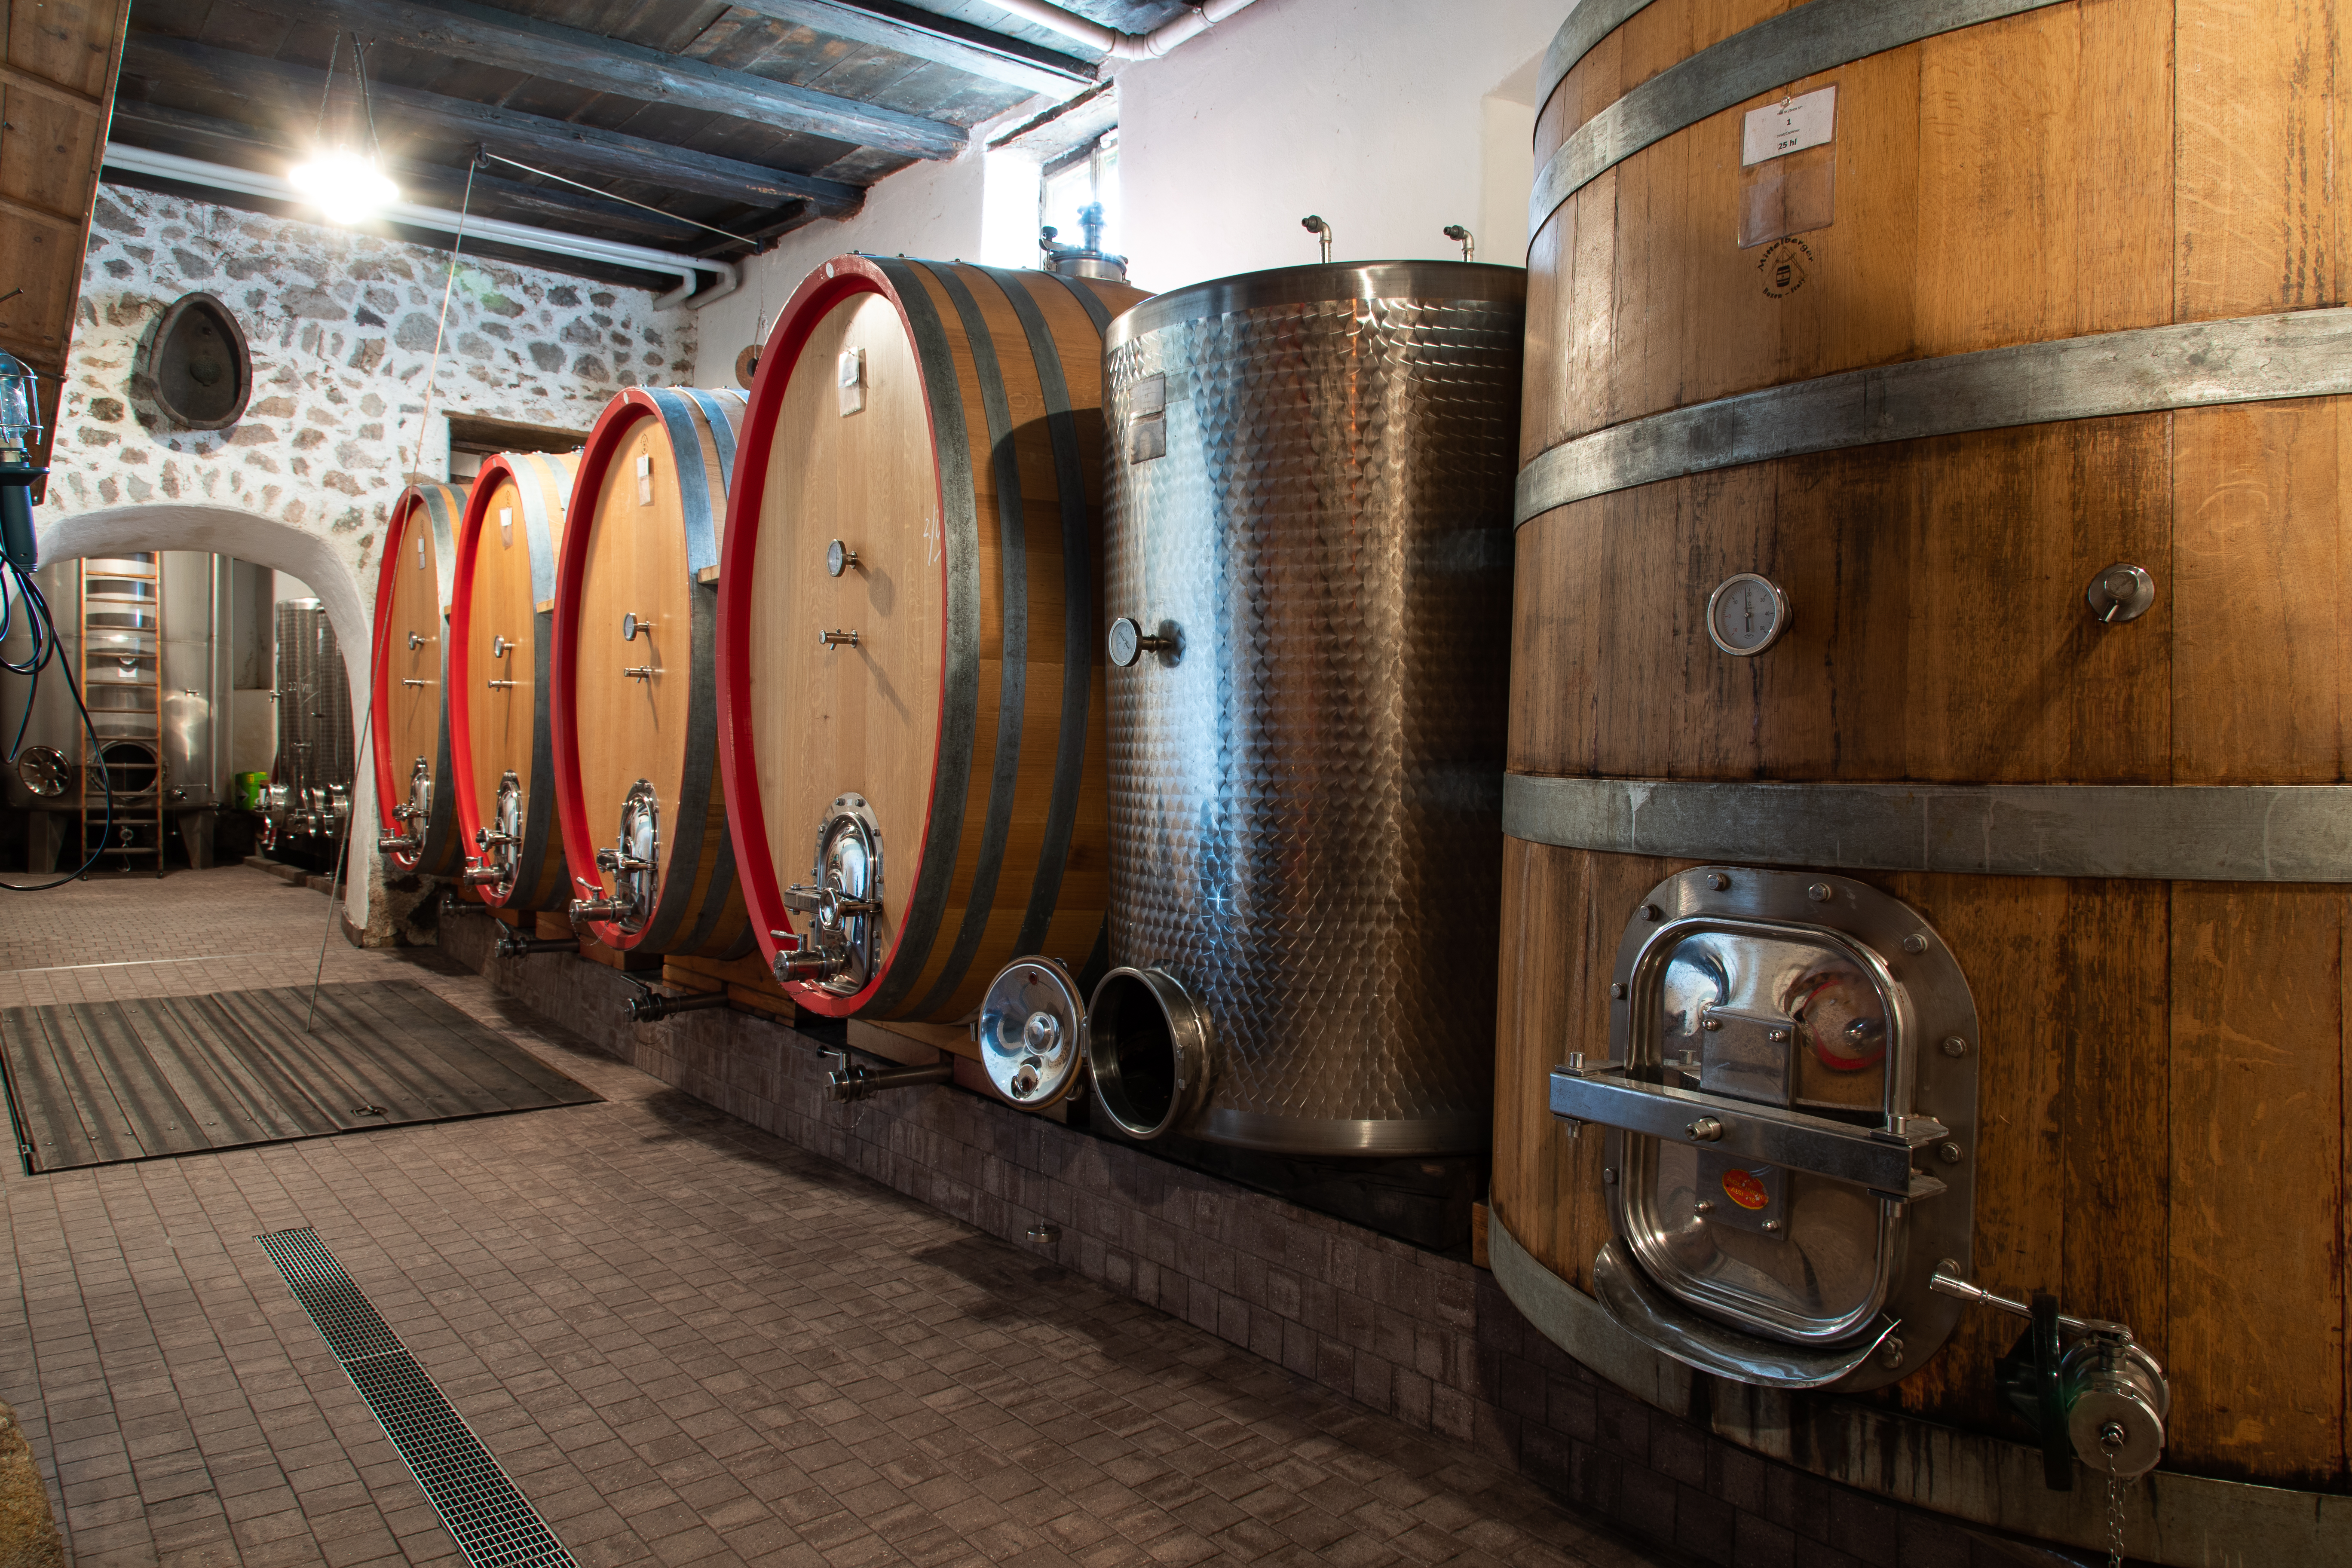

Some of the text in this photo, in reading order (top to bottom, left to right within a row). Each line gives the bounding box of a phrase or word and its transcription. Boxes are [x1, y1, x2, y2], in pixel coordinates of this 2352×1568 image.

[1778, 138, 1797, 150] 25 hl
[1757, 238, 1813, 272] Mittelberger
[1763, 287, 1782, 299] Bozen
[1790, 279, 1805, 293] Italy
[1730, 1187, 1744, 1197] AISI
